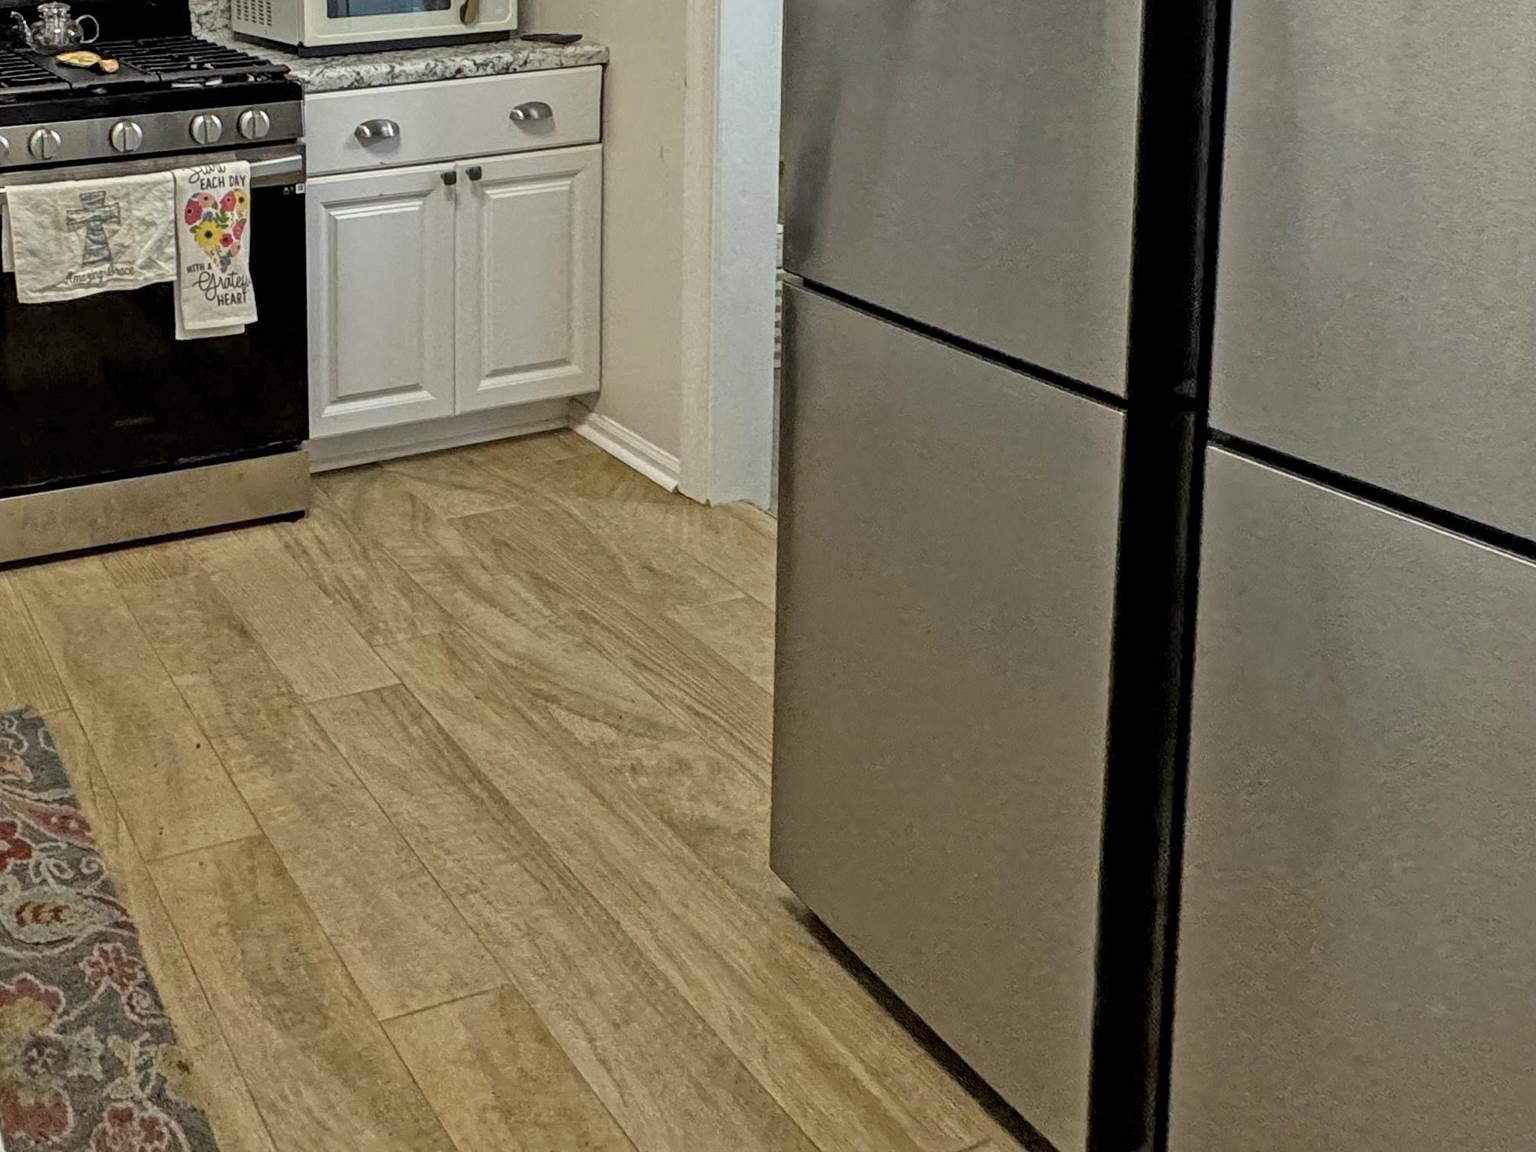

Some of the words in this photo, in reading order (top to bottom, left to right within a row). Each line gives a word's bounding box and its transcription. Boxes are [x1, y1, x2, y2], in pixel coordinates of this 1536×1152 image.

[200, 174, 226, 190] EACH
[228, 174, 247, 188] DAY
[186, 262, 205, 273] WITH
[207, 261, 213, 271] A
[217, 288, 248, 308] HEART
